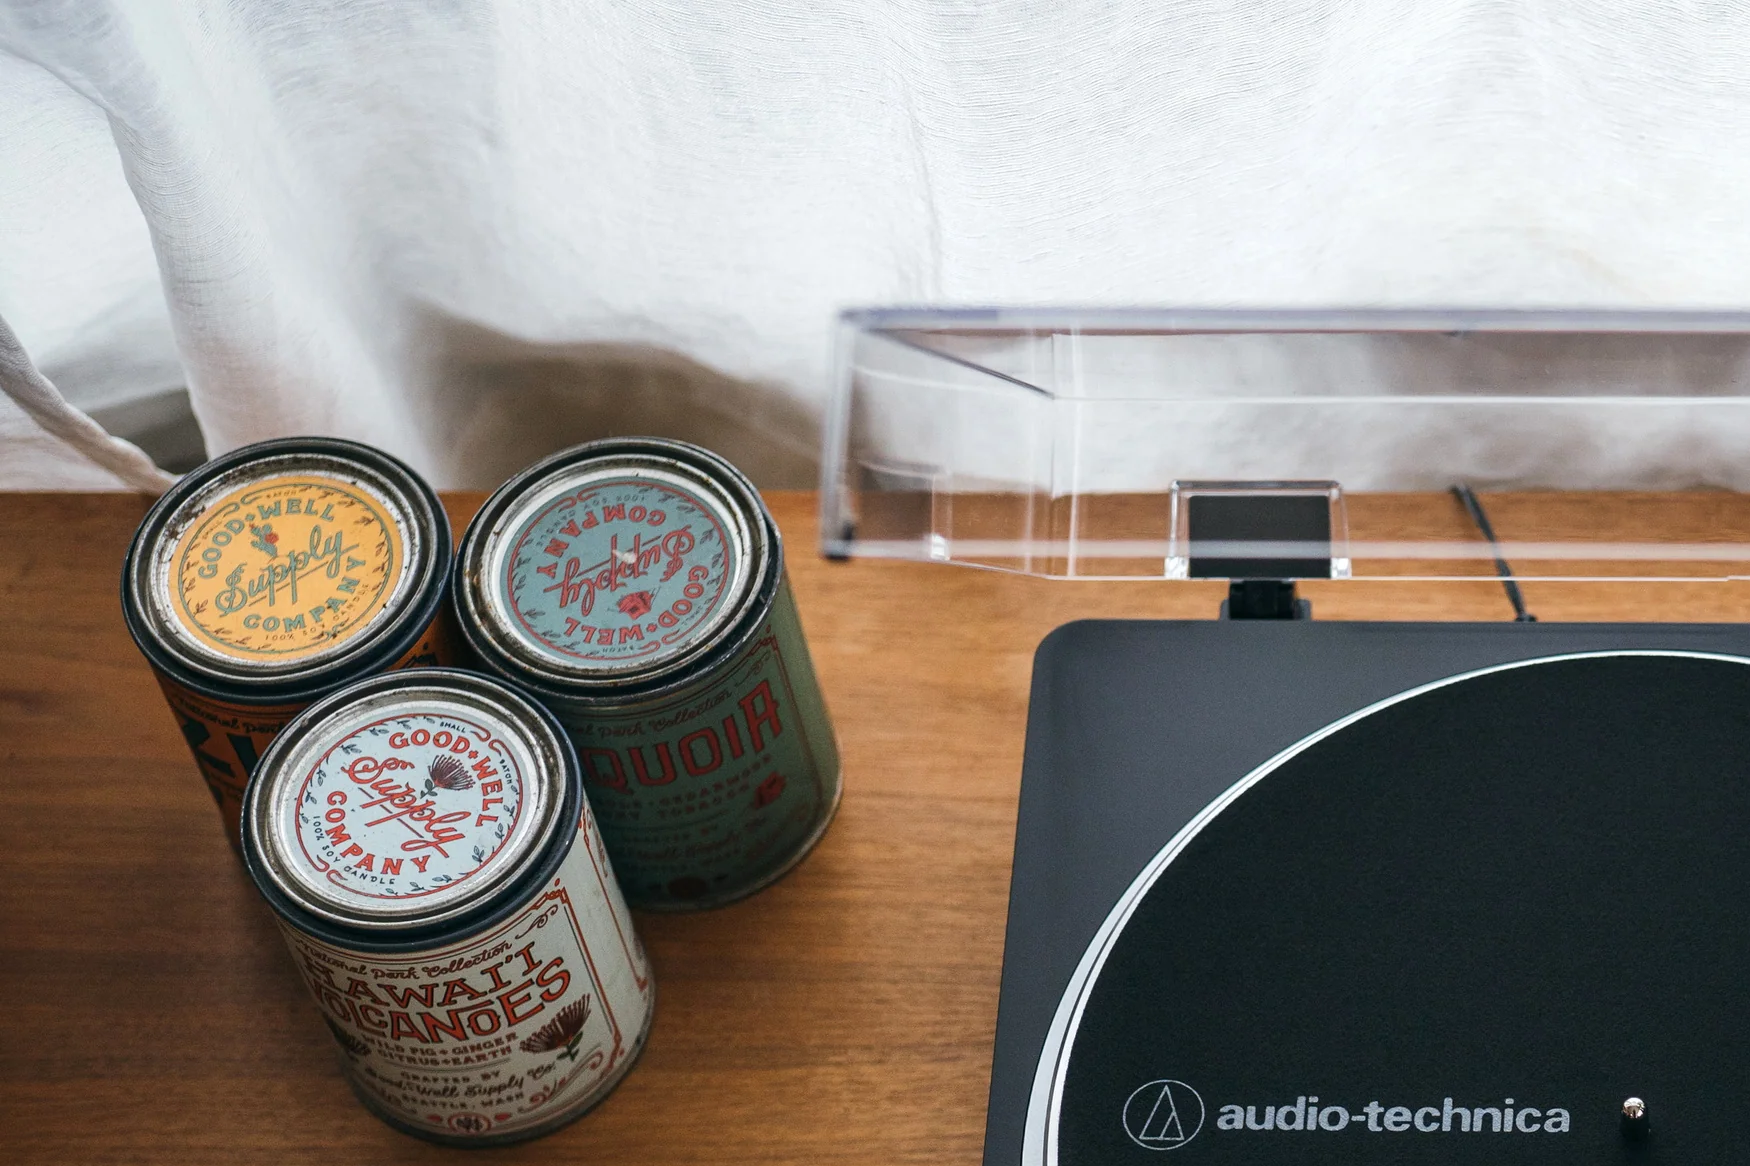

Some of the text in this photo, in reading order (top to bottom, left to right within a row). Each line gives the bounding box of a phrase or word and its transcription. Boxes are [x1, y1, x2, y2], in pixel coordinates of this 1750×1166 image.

[215, 525, 360, 619] Supply
[536, 504, 667, 578] COMPANY
[543, 525, 695, 618] Supply
[243, 556, 367, 632] COMPANY
[440, 721, 513, 785] SMALL BATCH
[581, 679, 783, 795] QUOIA
[325, 790, 431, 876] COMPANY
[340, 755, 472, 859] Supply
[313, 815, 396, 885] 100% SOY CANDLE
[308, 956, 572, 1045] VOLCANOES
[370, 965, 420, 981] Park
[422, 940, 513, 979] Collection
[1216, 1095, 1571, 1134] audio-technica
